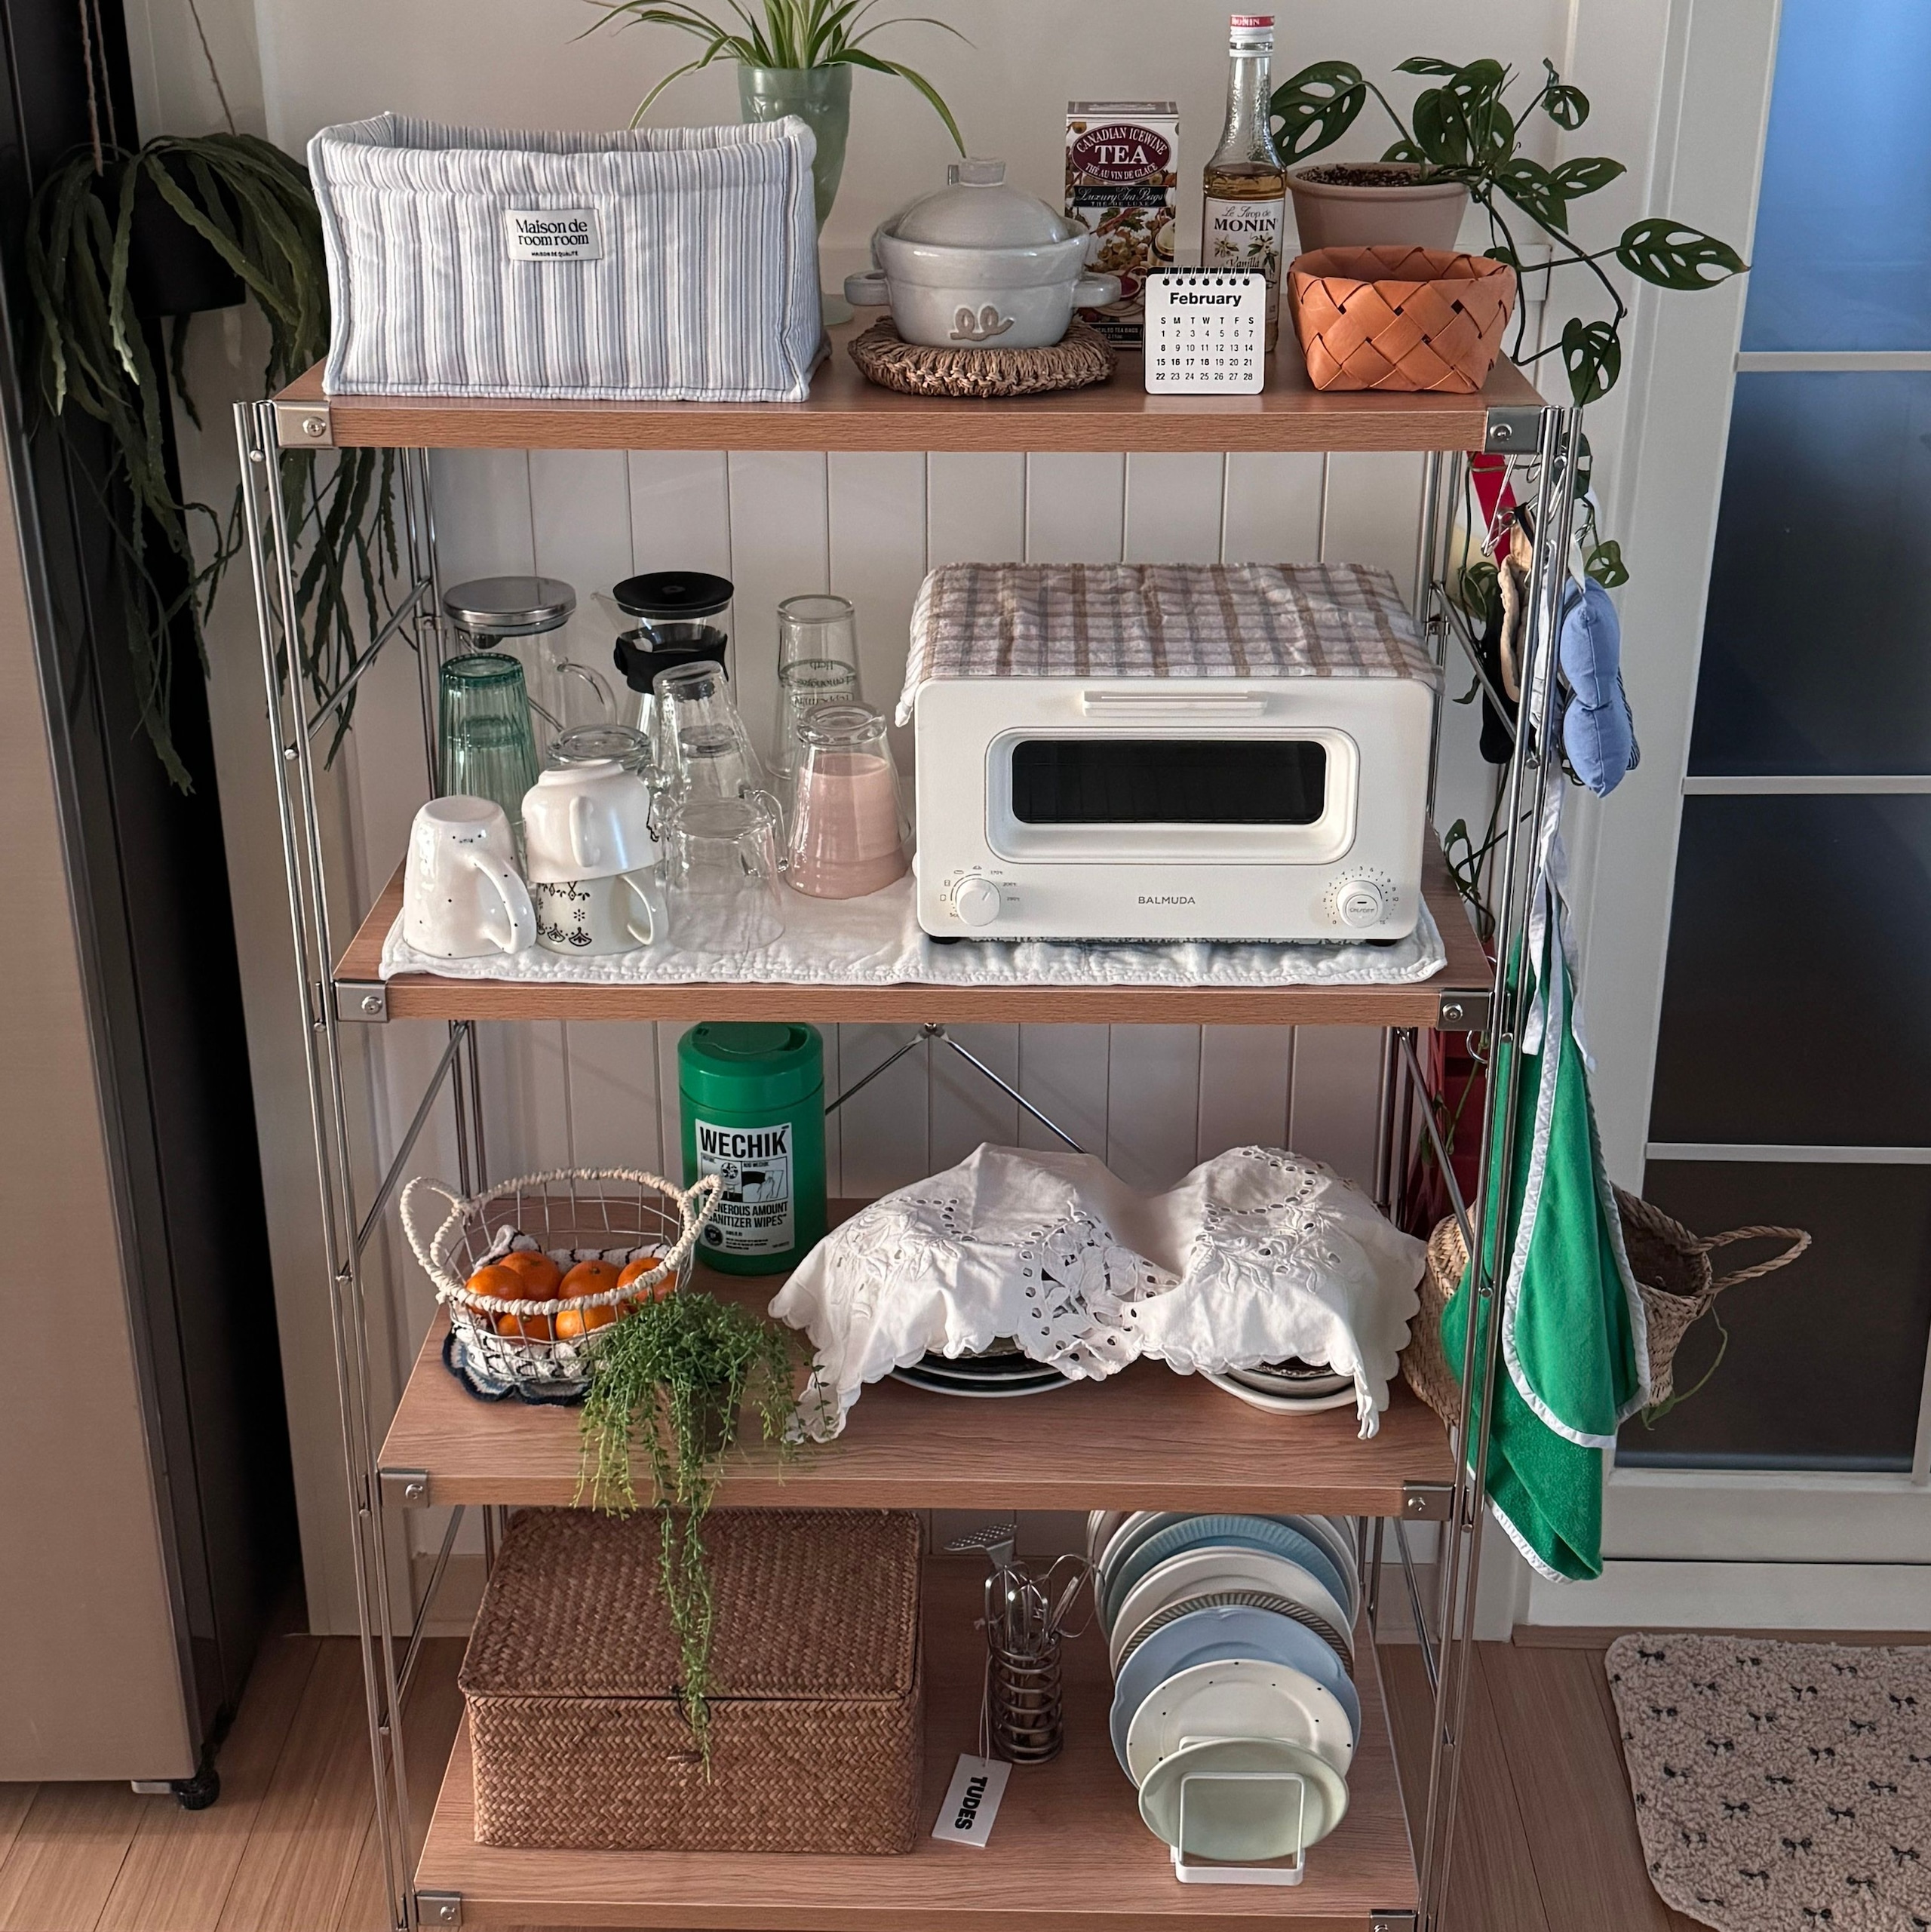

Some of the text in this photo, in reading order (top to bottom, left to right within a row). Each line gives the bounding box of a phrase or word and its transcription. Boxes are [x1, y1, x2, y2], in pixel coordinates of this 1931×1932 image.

[1076, 127, 1167, 155] CANADIAN ICEWINE
[1094, 145, 1148, 164] TEA
[1085, 163, 1158, 180] THÉ AU VIN DE GLACE
[1076, 186, 1162, 204] Luxury Tea Bags
[1222, 206, 1236, 217] Le
[1238, 206, 1260, 220] Sirop
[516, 219, 588, 233] Maison de
[1214, 218, 1276, 232] MONIN
[518, 235, 589, 246] room room
[1170, 292, 1242, 307] February
[1138, 896, 1196, 905] BALMUDA
[700, 1126, 787, 1158] WECHIK
[714, 1201, 788, 1216] NEROUS AMOUNT
[954, 1777, 988, 1829] TUDES
